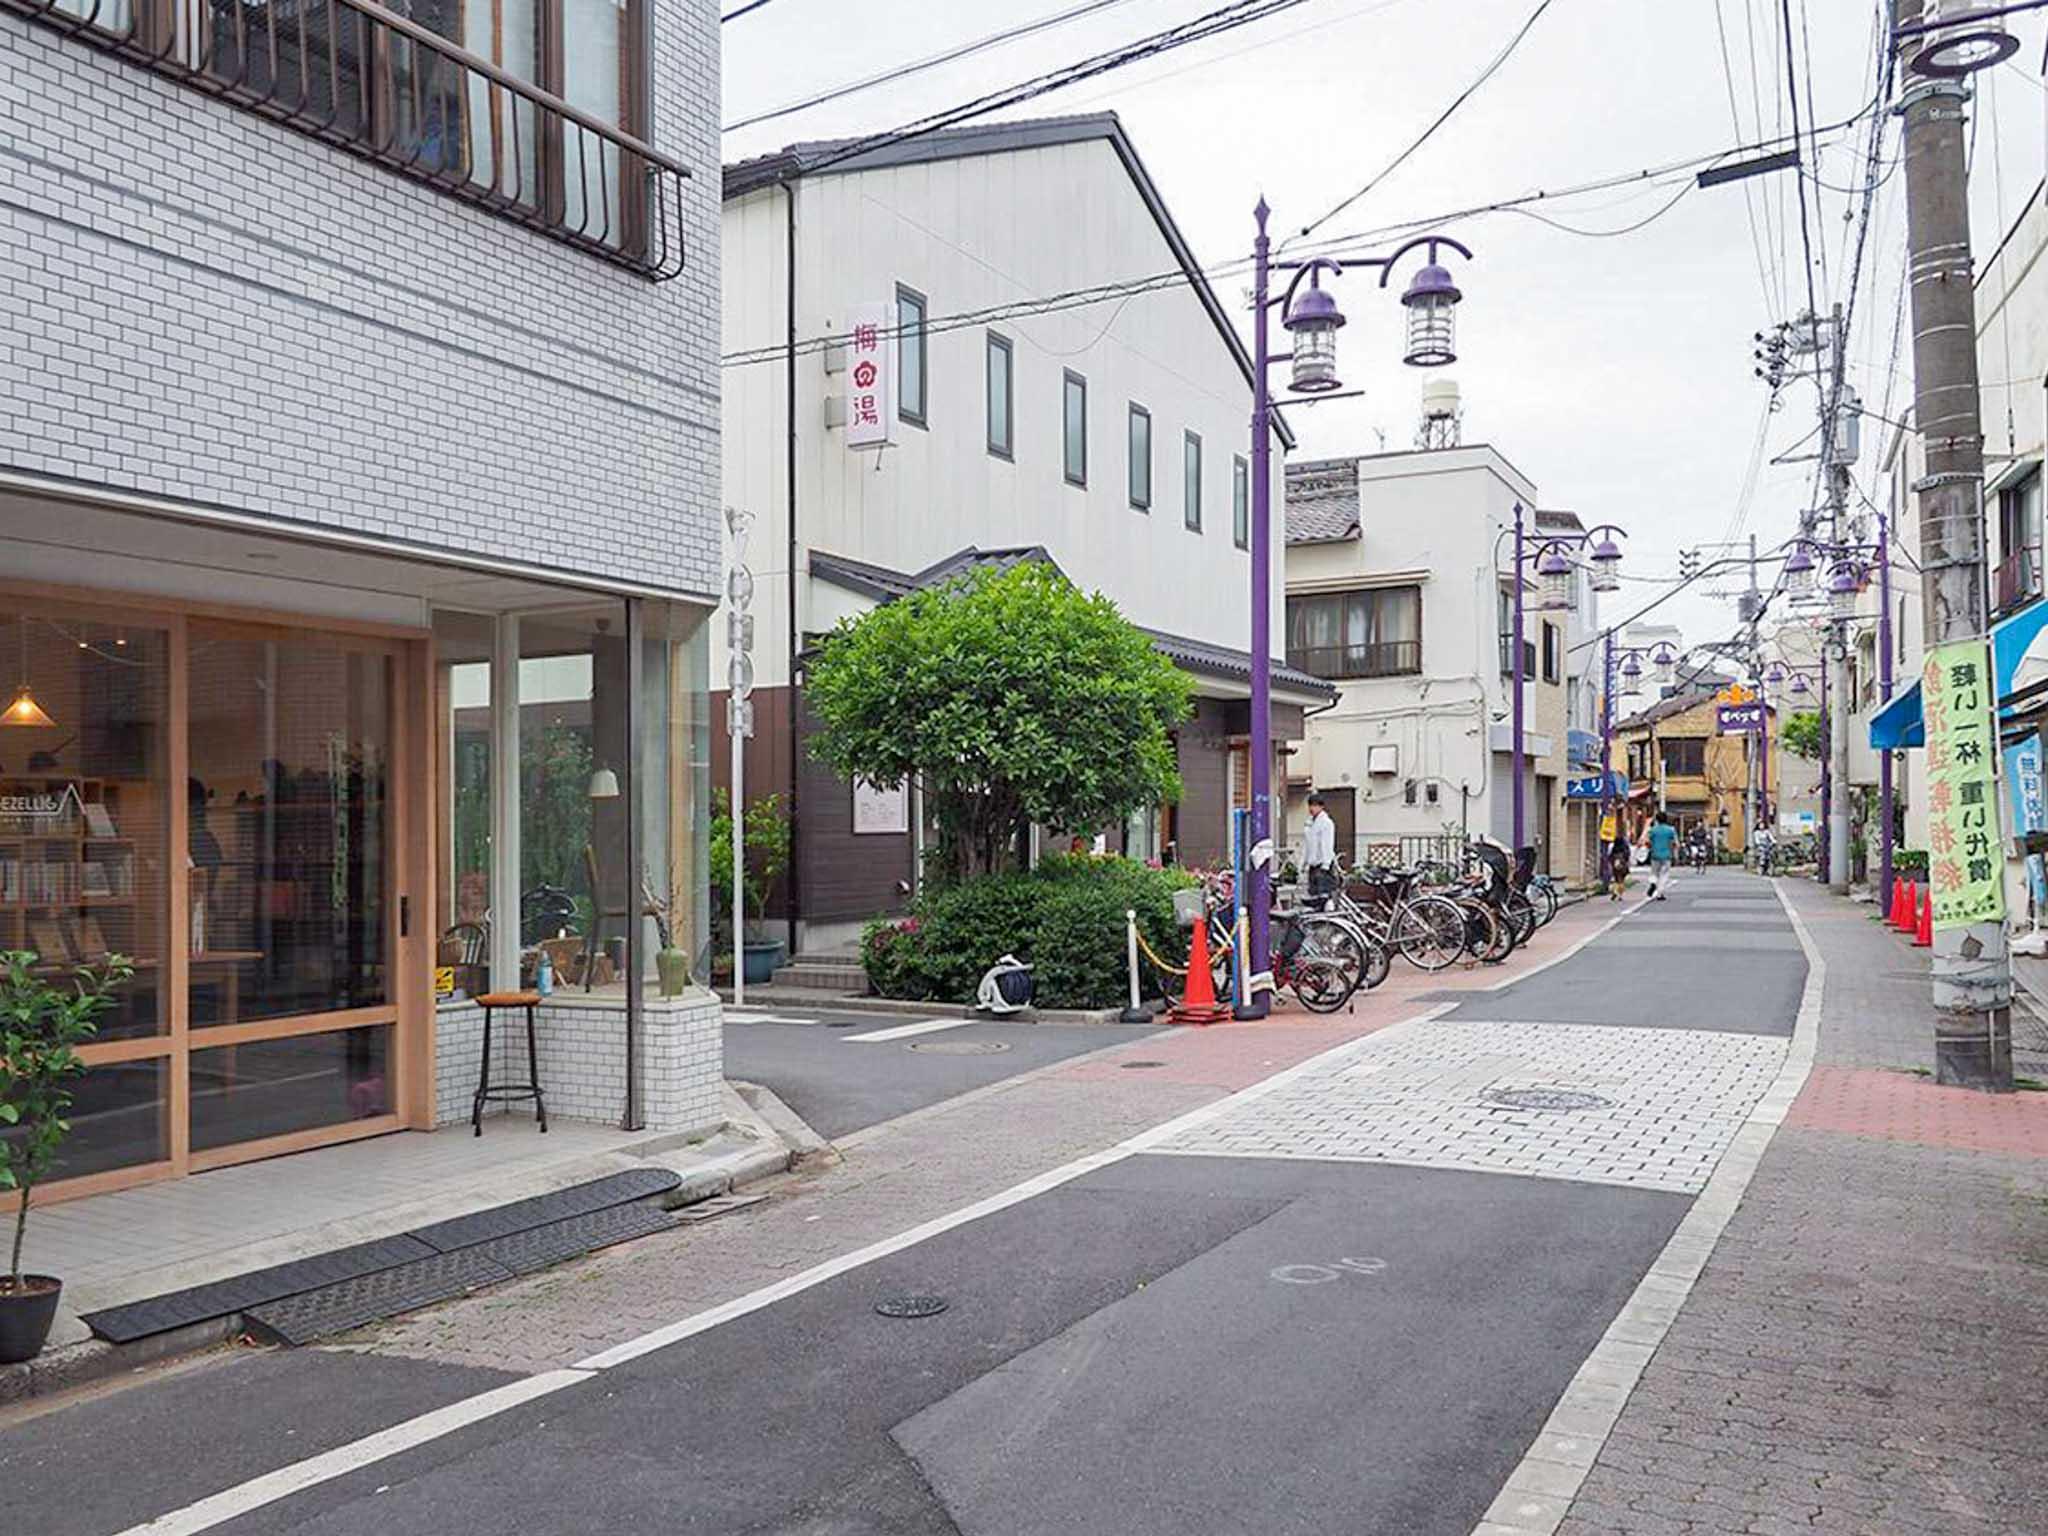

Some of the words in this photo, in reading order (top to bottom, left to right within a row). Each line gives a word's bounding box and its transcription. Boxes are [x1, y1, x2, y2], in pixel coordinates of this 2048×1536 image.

[852, 322, 878, 427] 梅の湯
[0, 795, 57, 811] EZELLIG
